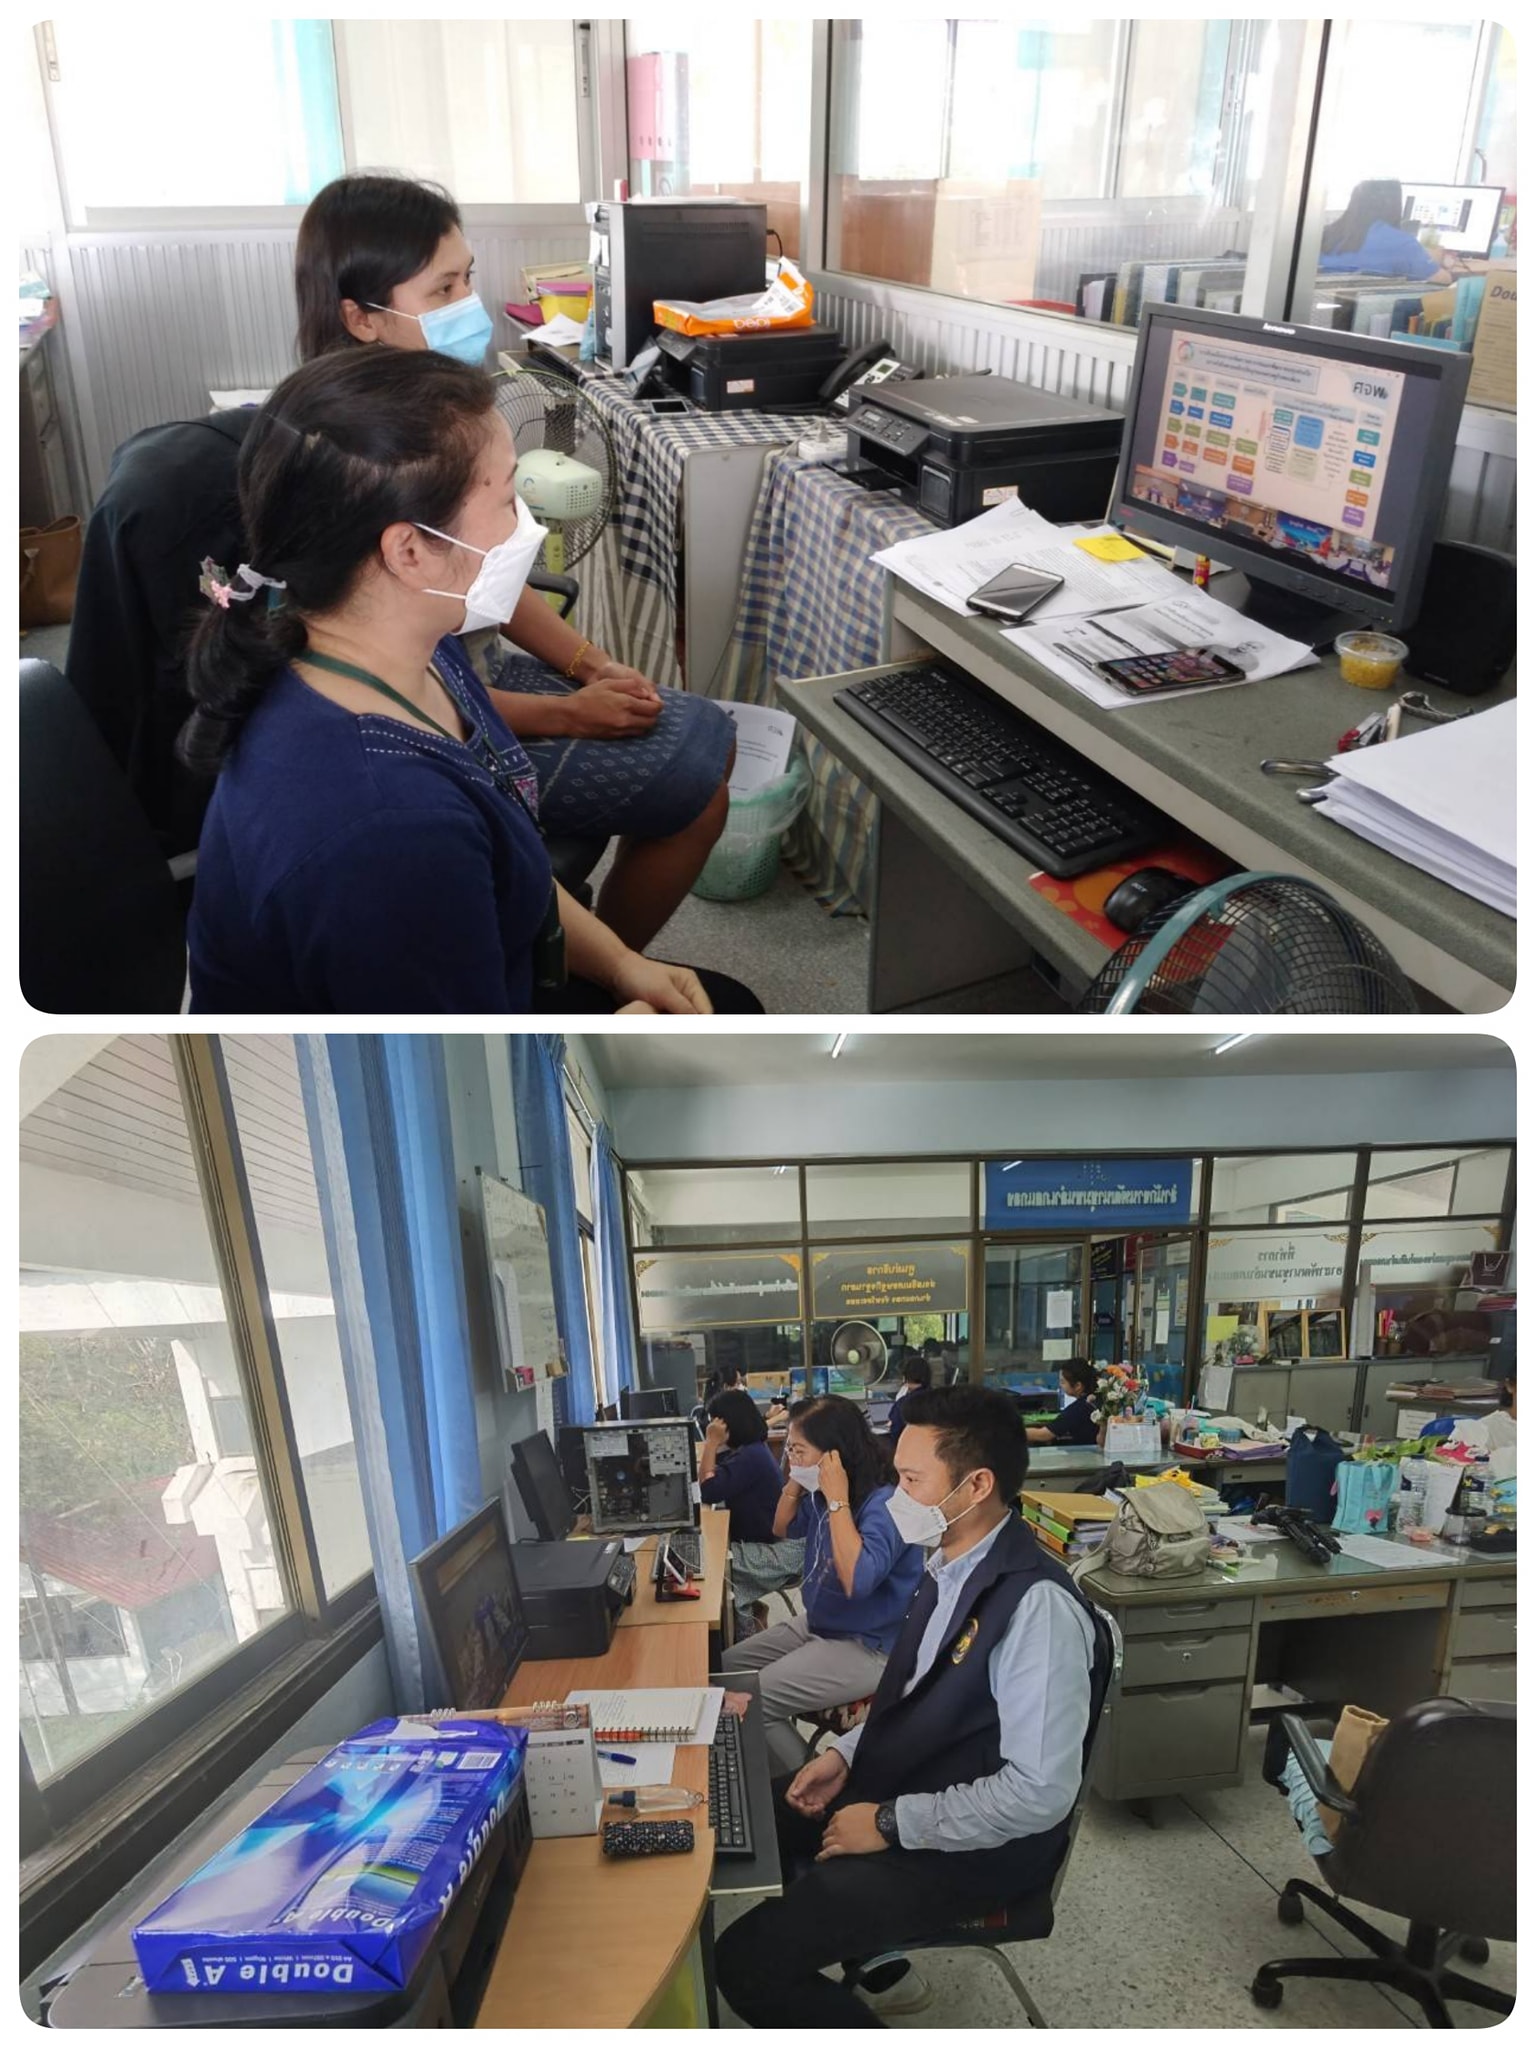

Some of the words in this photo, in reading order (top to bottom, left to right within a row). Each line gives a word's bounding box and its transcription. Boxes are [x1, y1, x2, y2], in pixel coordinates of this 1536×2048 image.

[309, 1907, 392, 1928] Double
[205, 1964, 226, 1985] A
[240, 1962, 353, 1984] Double
